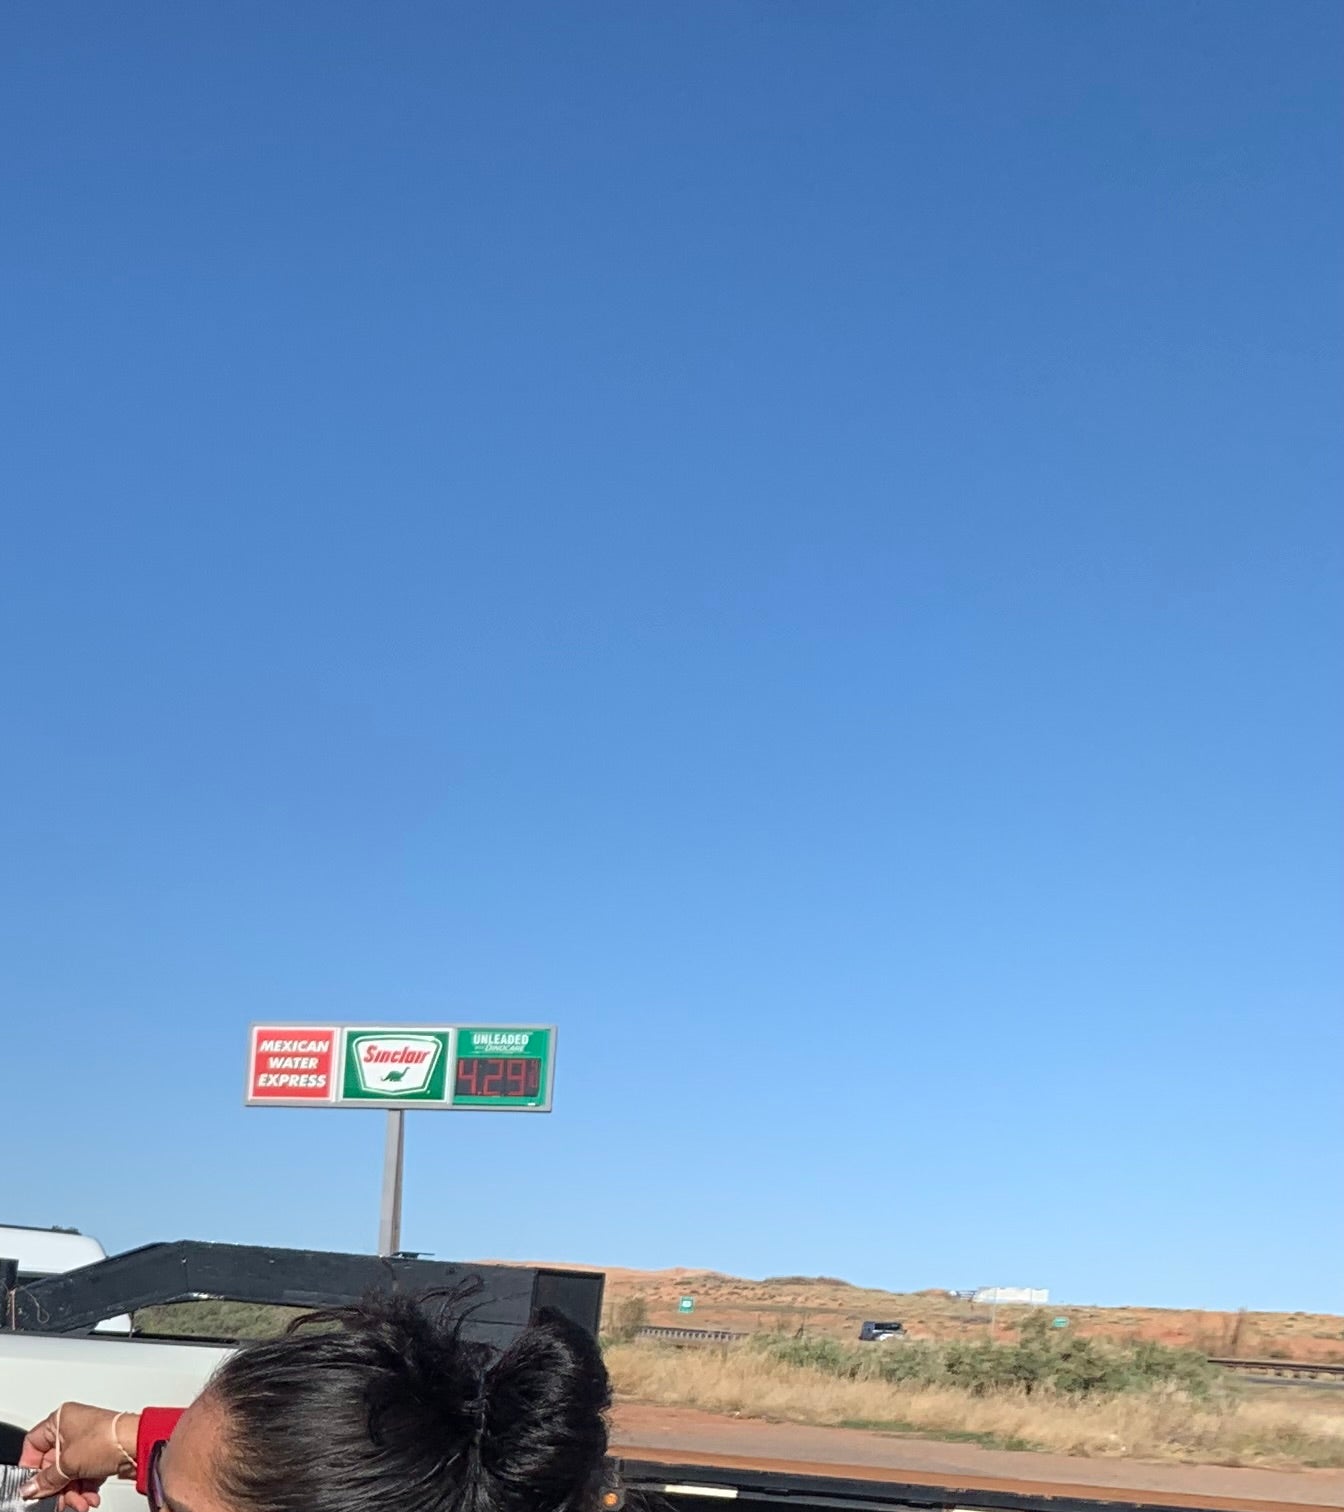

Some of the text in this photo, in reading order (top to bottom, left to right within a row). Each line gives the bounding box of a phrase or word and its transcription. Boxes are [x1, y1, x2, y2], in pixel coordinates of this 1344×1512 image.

[473, 1033, 529, 1045] UNLEADED
[260, 1040, 329, 1053] MEXICAN
[363, 1045, 431, 1064] Sinclair
[267, 1057, 319, 1070] WATER
[257, 1073, 327, 1088] EXPRESS
